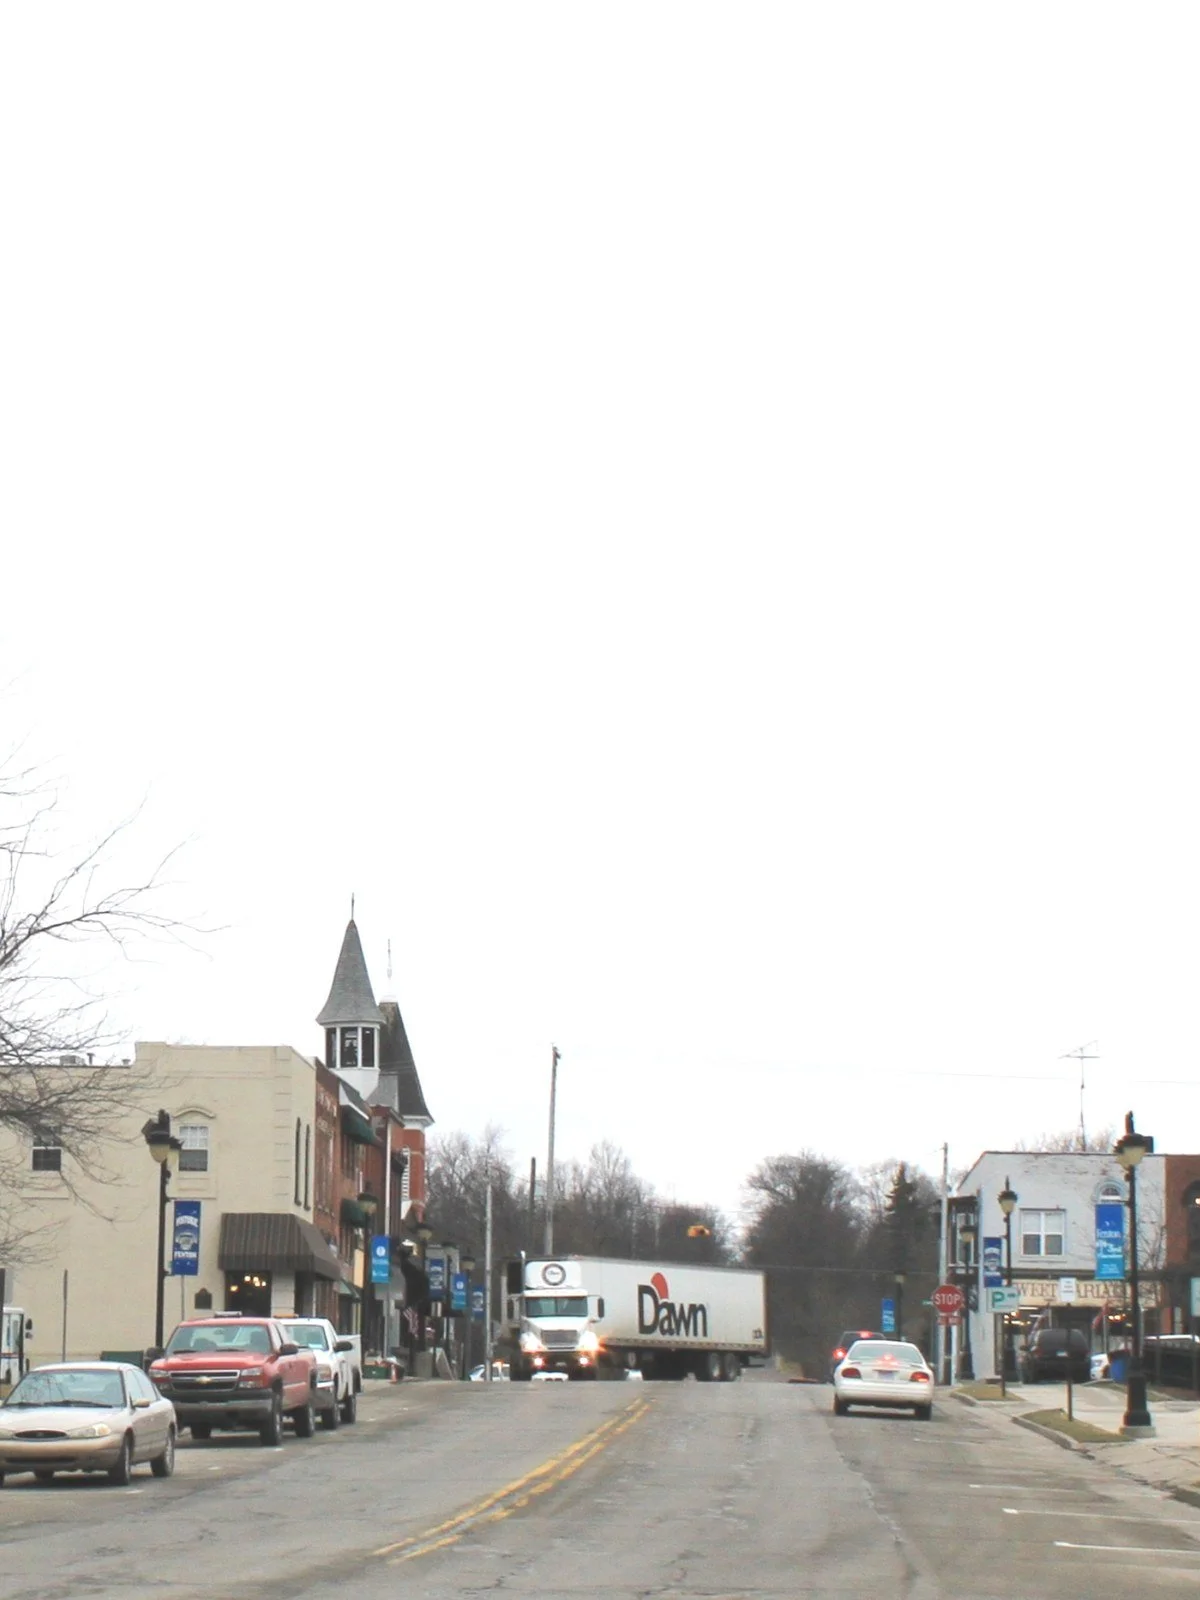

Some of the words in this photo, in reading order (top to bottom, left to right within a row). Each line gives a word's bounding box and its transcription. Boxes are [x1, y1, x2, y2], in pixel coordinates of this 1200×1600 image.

[1014, 1283, 1057, 1298] WEET
[935, 1293, 961, 1305] STOP
[638, 1284, 708, 1337] Dawn
